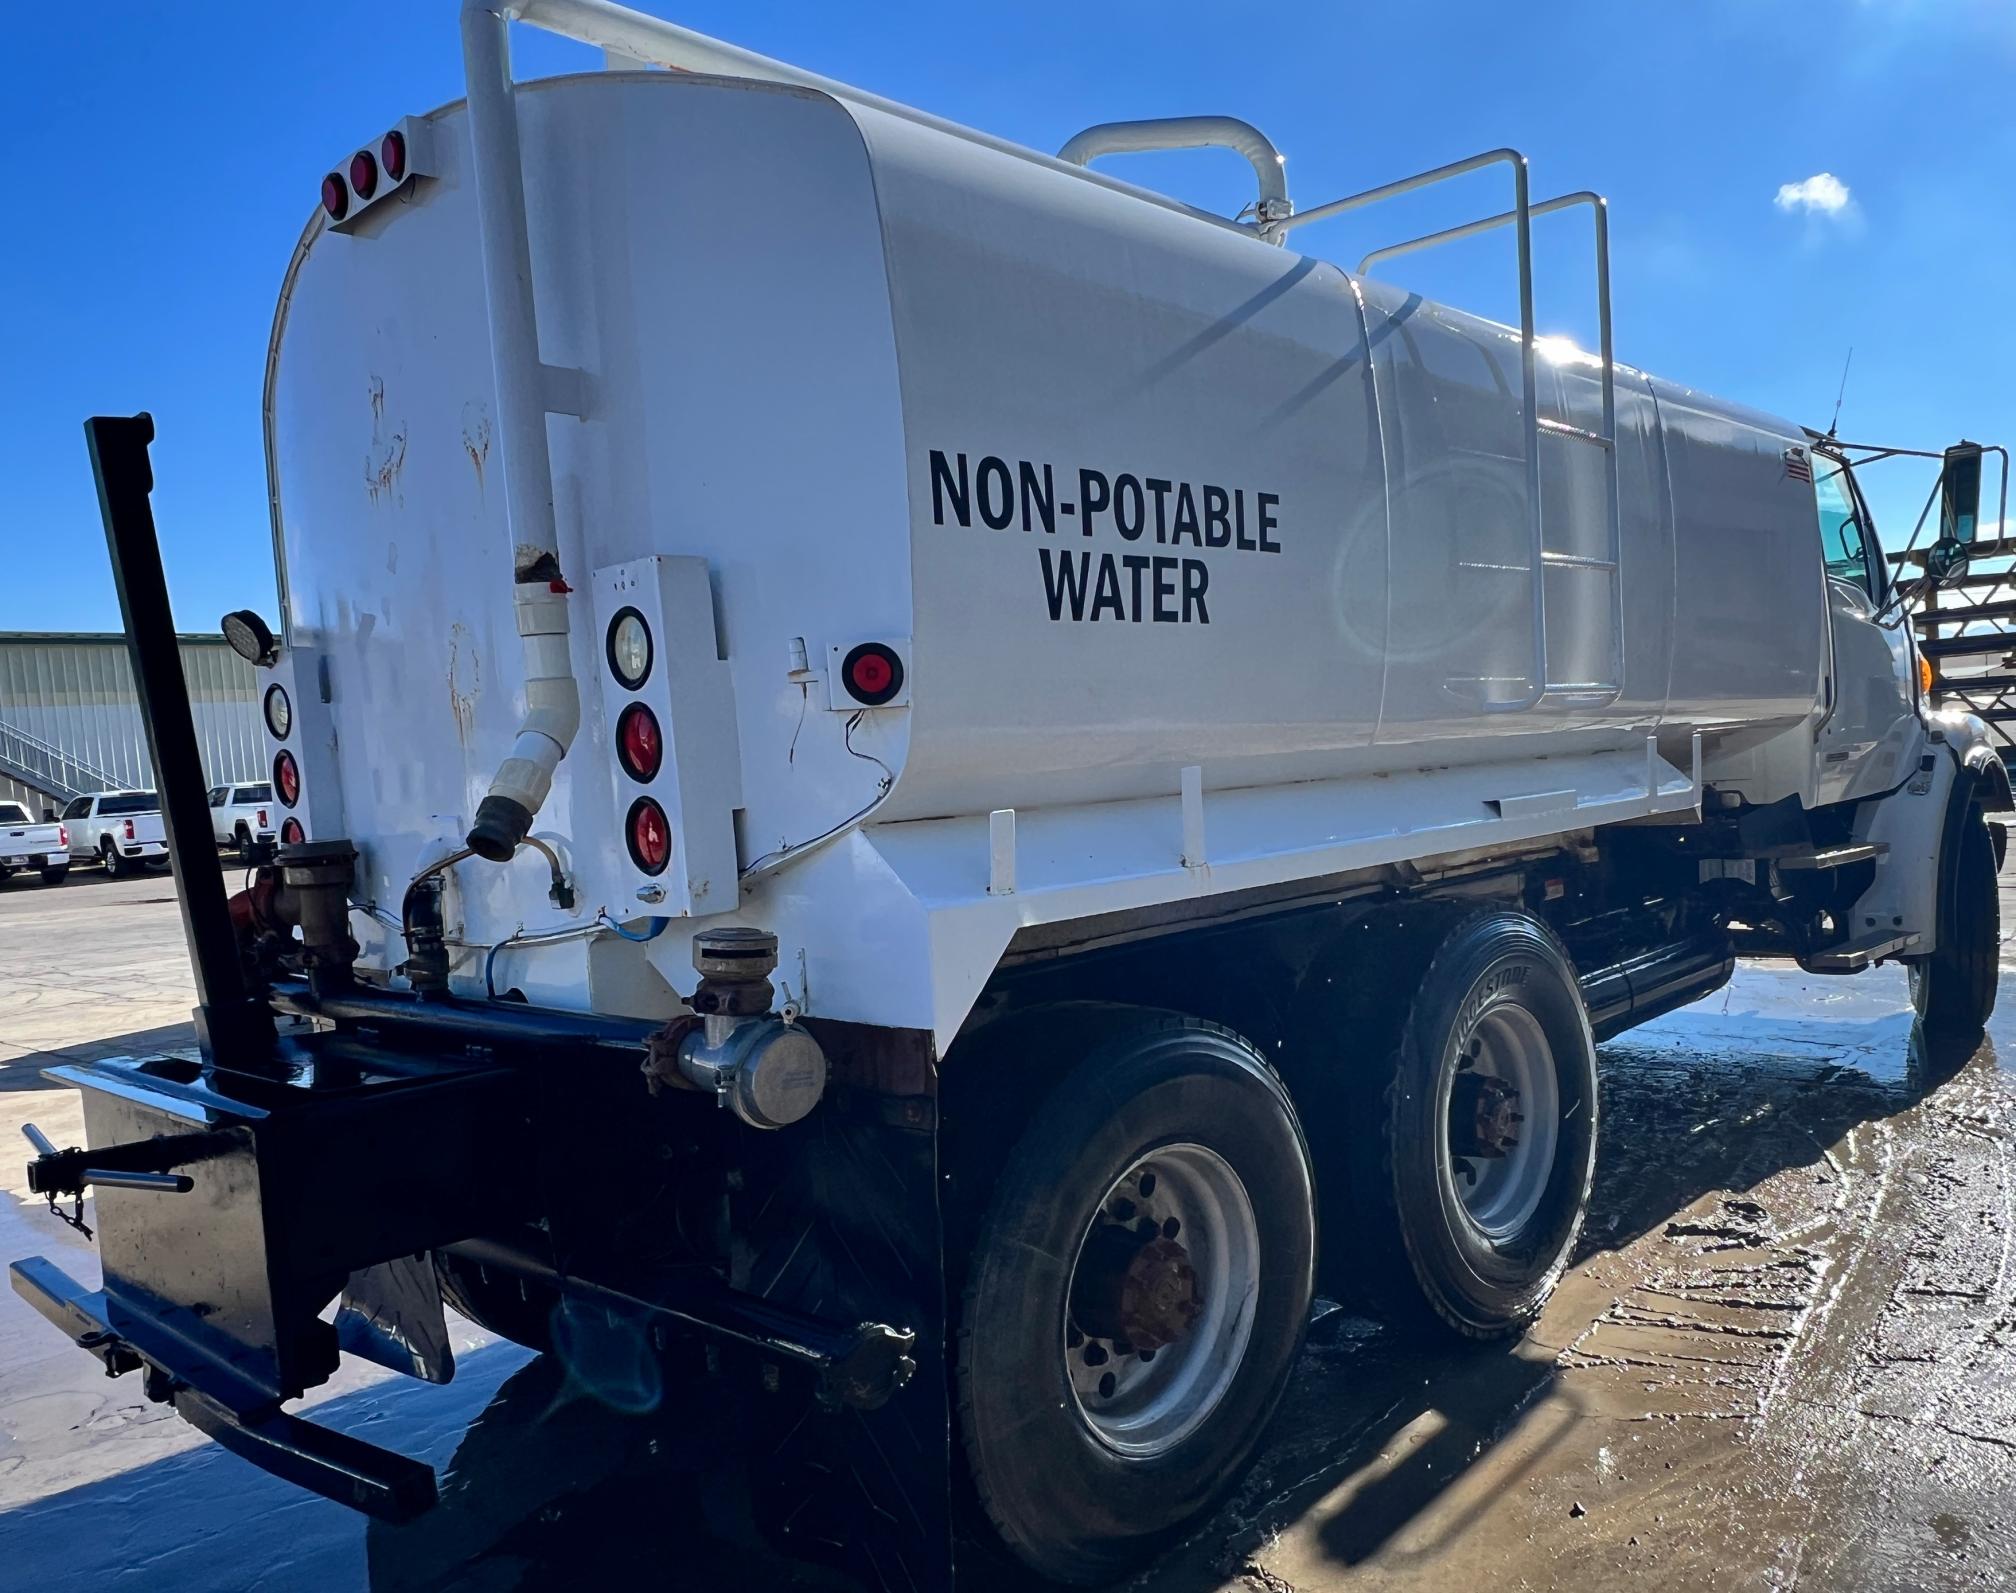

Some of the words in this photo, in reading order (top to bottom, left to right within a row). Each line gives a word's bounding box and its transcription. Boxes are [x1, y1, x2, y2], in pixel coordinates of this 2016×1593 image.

[929, 449, 1281, 553] NON-POTABLE
[1038, 548, 1210, 624] WATER
[1452, 966, 1533, 1056] IDGESTONE
